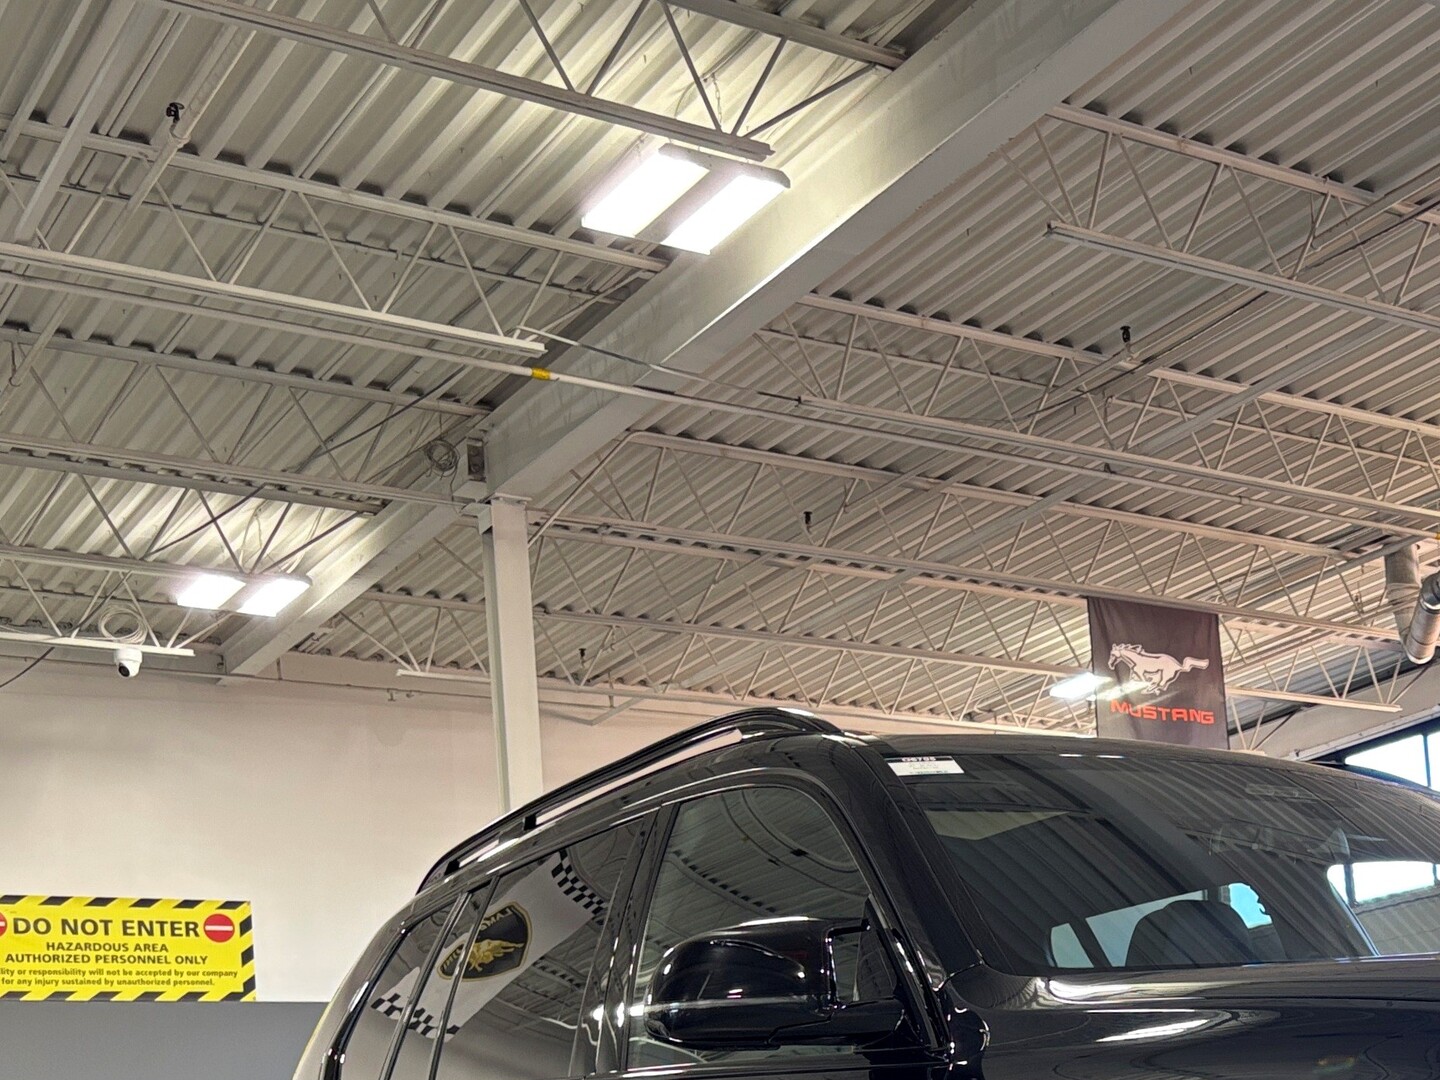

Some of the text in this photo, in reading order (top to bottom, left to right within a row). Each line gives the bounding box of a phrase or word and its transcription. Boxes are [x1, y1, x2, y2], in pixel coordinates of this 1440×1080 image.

[1110, 699, 1215, 725] MUSTANG
[13, 918, 200, 938] DO NOT ENTER
[46, 942, 169, 953] HAZARDOUS AREA
[5, 953, 209, 965] AUTHORIZED PERSONNEL ONLY
[28, 968, 86, 977] responsibility
[135, 969, 172, 977] accepted
[174, 969, 185, 977] by
[202, 970, 238, 978] company
[16, 979, 32, 987] any
[34, 978, 59, 987] injury
[61, 978, 102, 986] sustained
[104, 978, 114, 987] by
[116, 978, 171, 986] unauthorized
